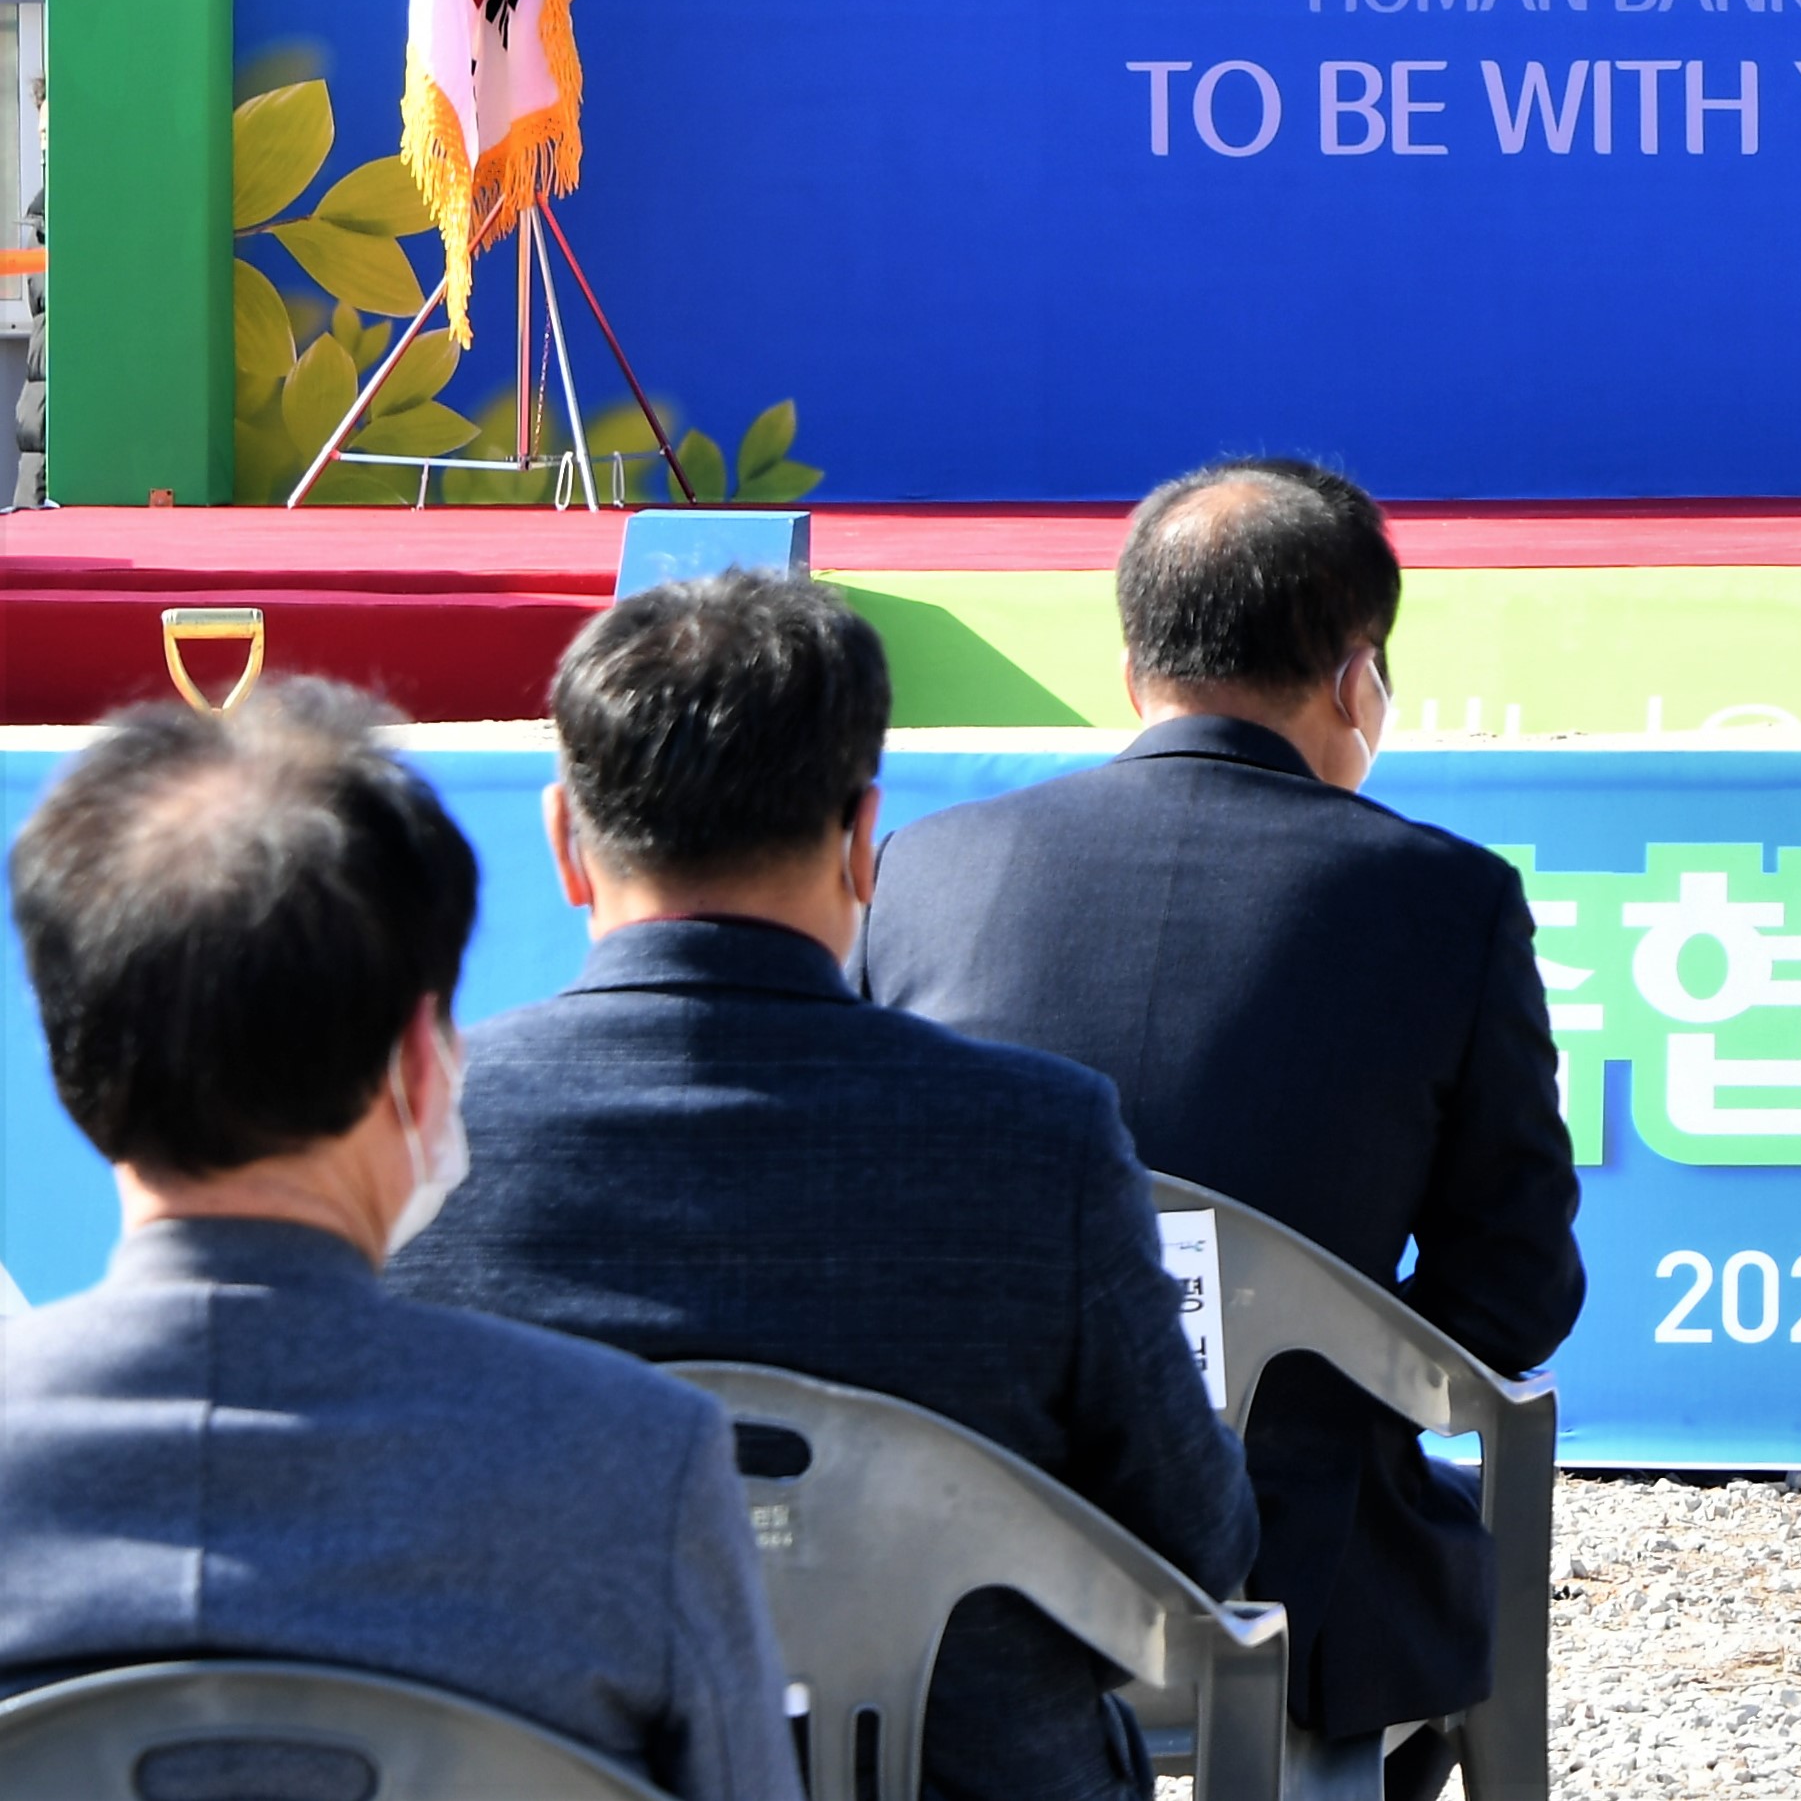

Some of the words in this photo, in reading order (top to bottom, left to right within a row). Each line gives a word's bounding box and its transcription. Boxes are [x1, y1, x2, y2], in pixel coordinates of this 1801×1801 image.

[1125, 60, 1282, 157] TO
[1319, 60, 1448, 156] BE
[1480, 60, 1760, 156] WITH
